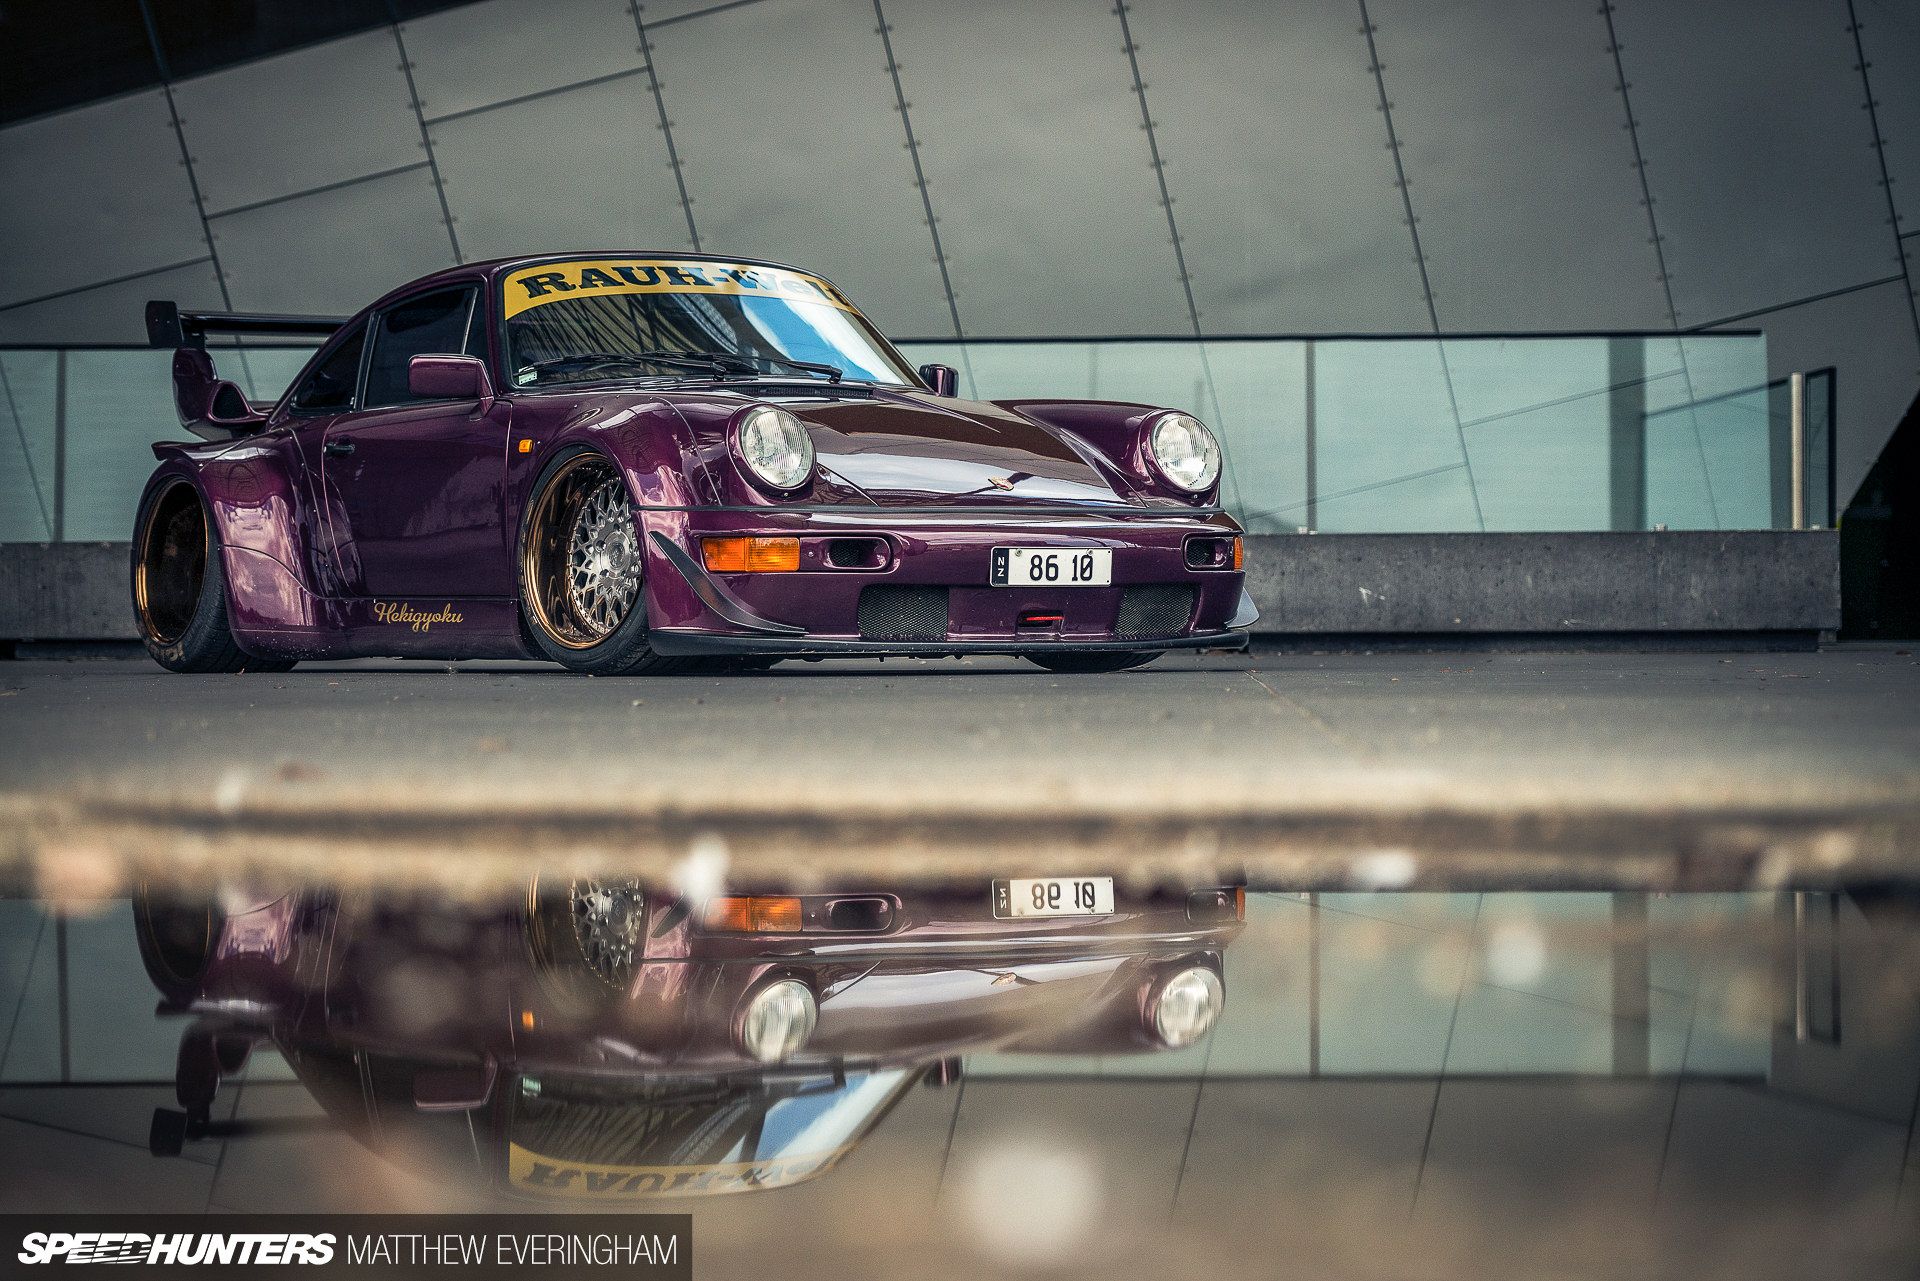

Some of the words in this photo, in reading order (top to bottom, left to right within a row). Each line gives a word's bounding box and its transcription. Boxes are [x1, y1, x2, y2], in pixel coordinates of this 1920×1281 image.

[997, 556, 1005, 577] NZ
[1029, 554, 1059, 582] 86
[1071, 554, 1094, 582] 10
[374, 602, 464, 632] Hekigyoku
